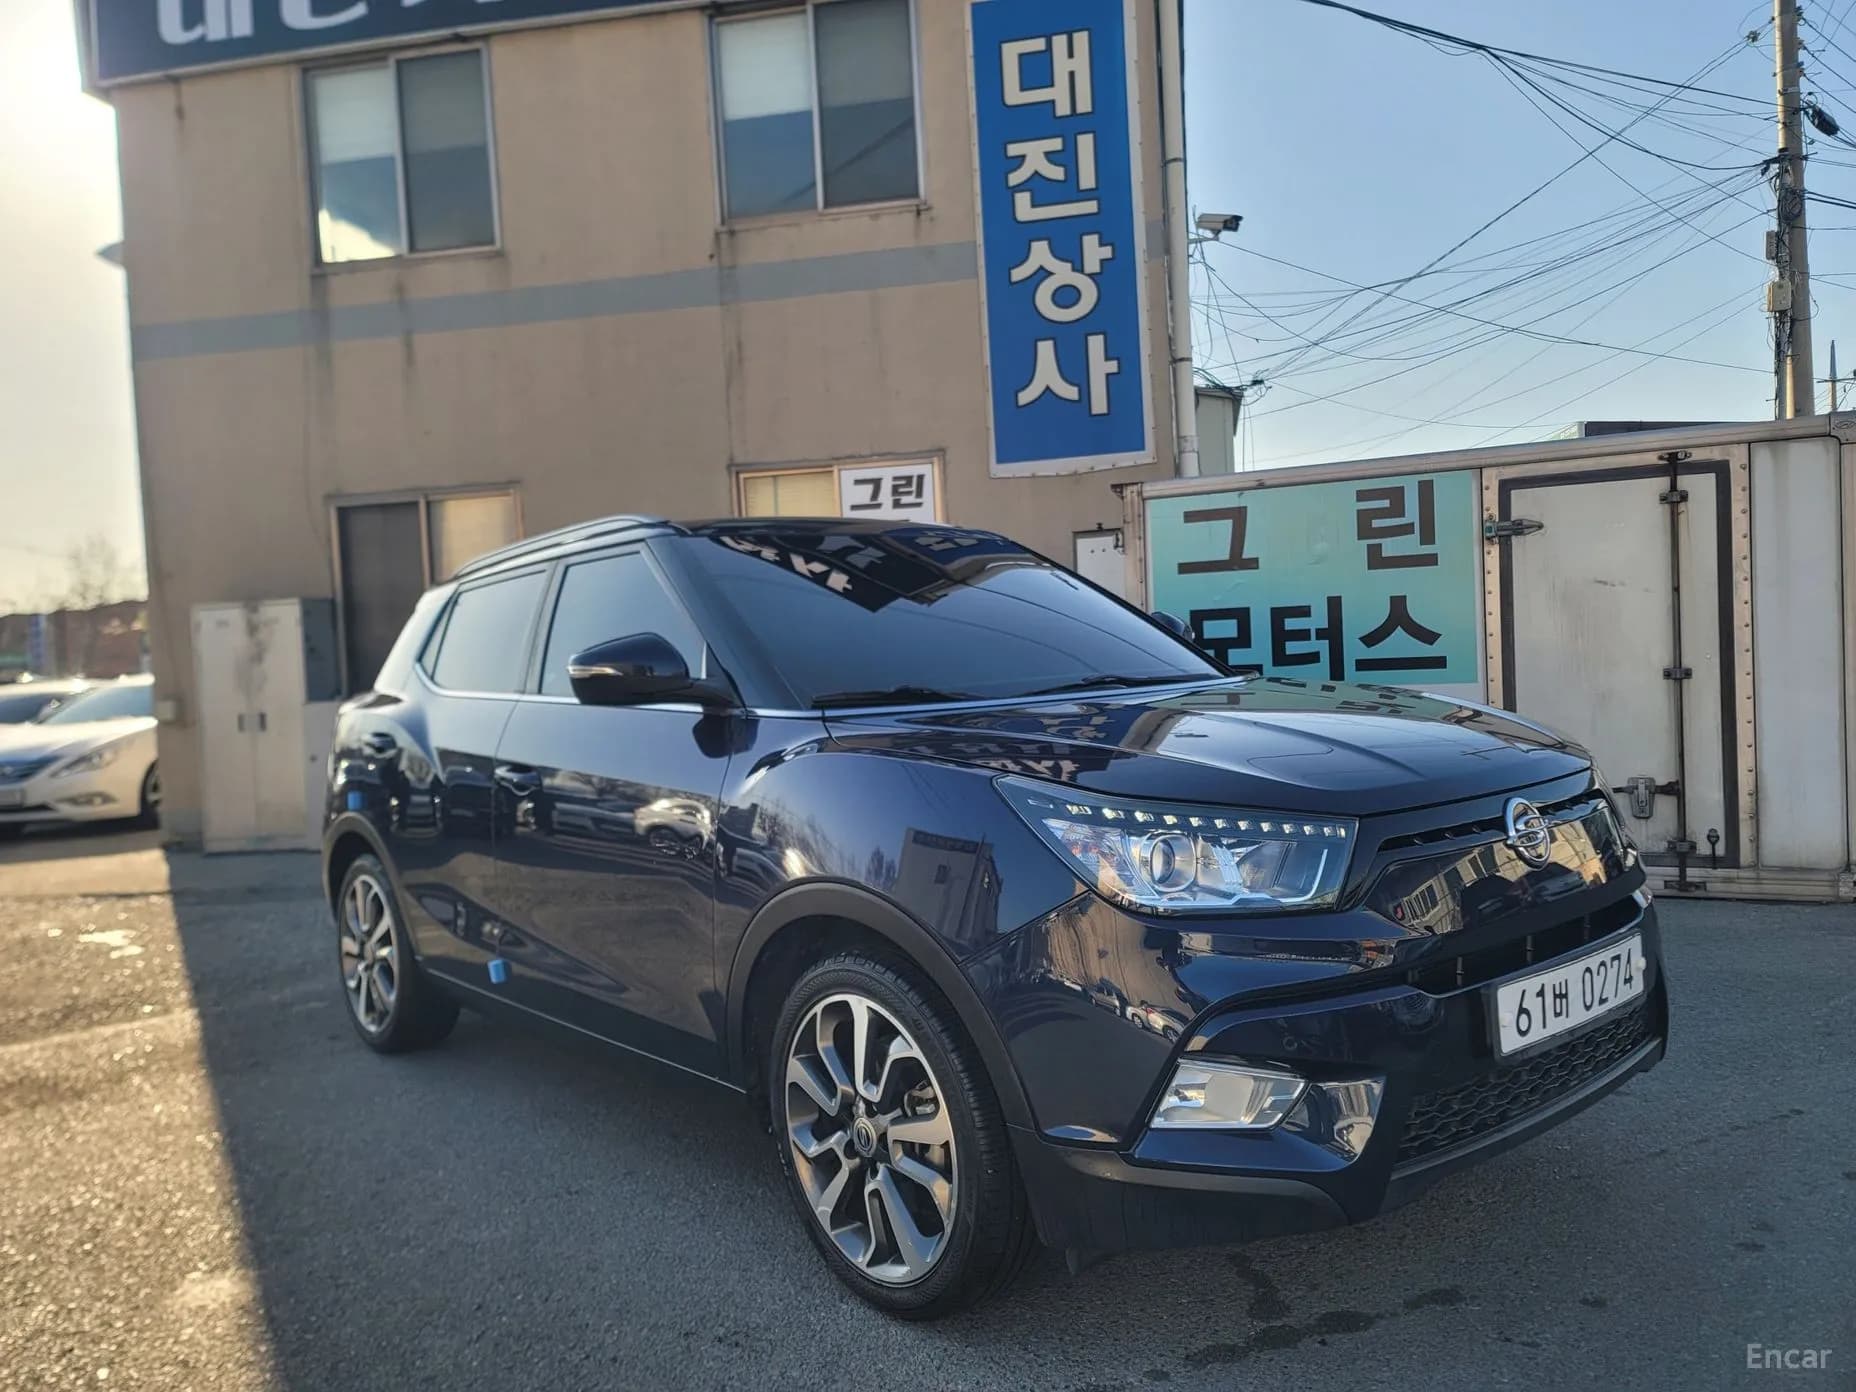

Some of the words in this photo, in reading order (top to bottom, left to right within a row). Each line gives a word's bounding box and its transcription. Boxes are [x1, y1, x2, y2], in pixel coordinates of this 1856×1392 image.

[999, 27, 1121, 417] 대진상사
[850, 473, 925, 511] 그린
[1190, 594, 1448, 681] 모터스
[1516, 979, 1569, 1037] 61버
[1582, 948, 1633, 1011] 0274
